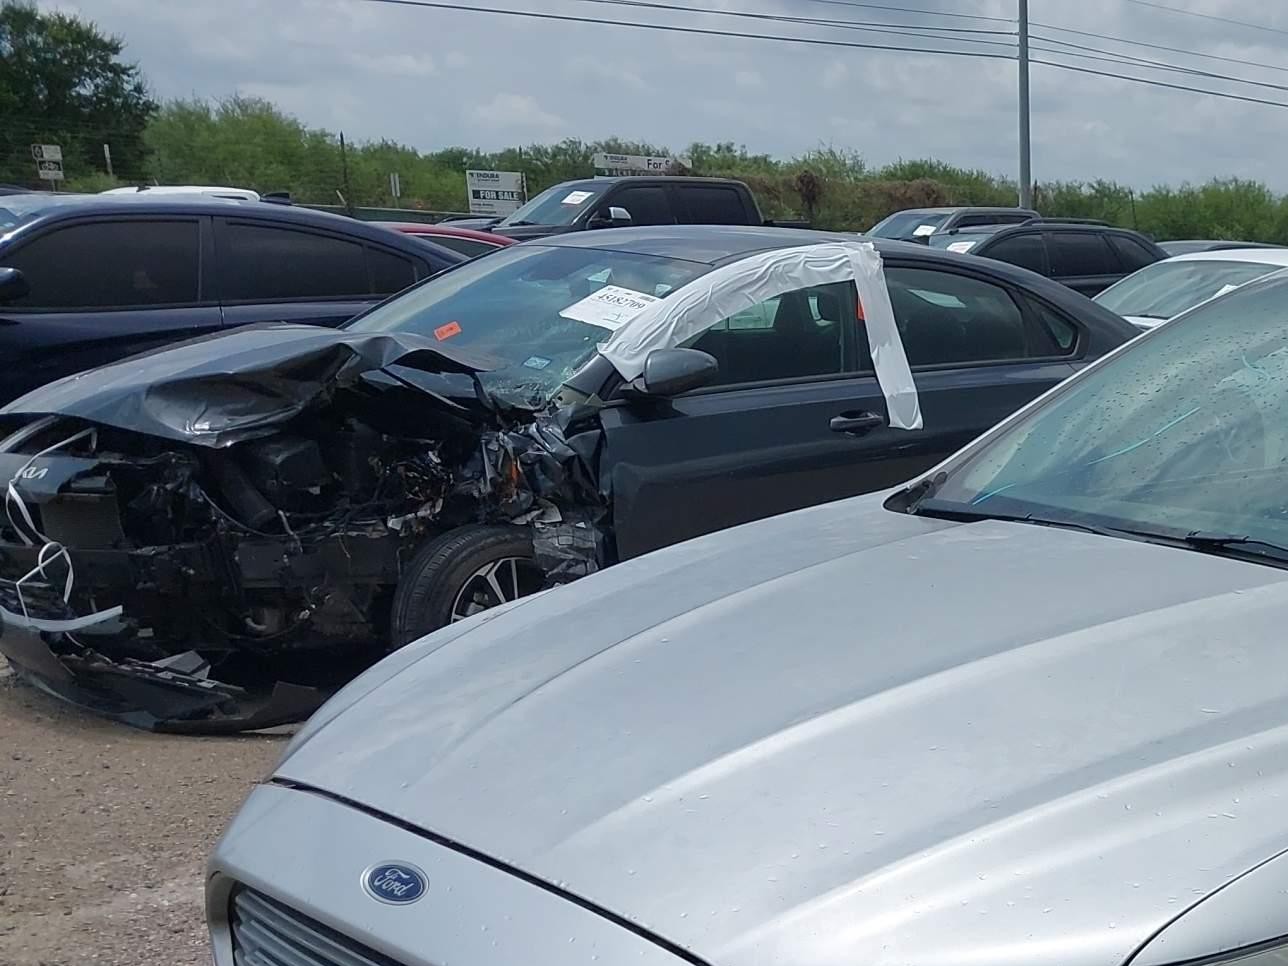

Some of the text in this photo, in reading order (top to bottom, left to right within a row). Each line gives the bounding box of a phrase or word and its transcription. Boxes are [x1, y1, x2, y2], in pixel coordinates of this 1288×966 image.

[647, 159, 664, 169] For
[480, 191, 519, 200] FOR SALE
[373, 868, 415, 896] Ford
